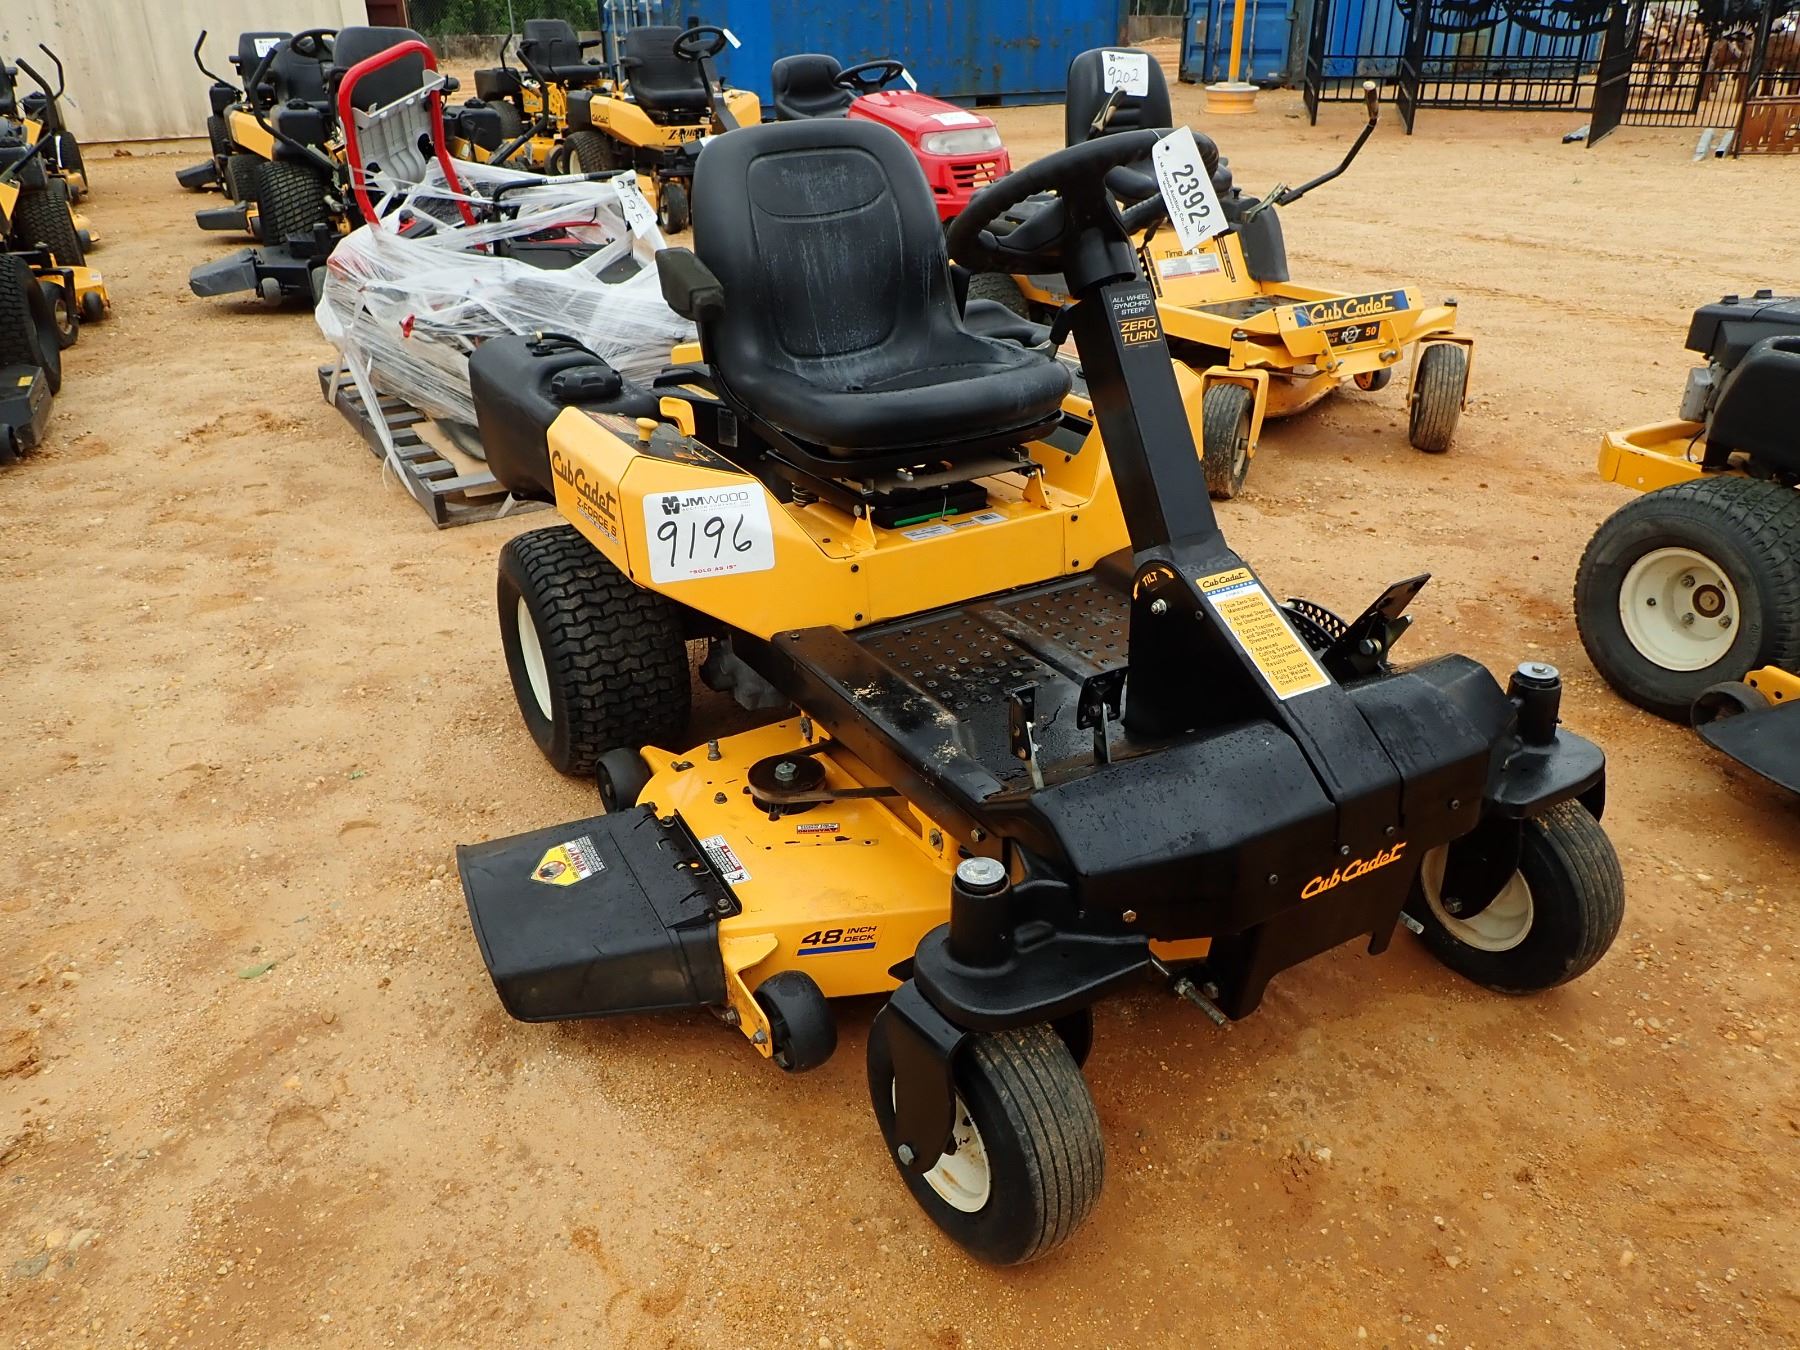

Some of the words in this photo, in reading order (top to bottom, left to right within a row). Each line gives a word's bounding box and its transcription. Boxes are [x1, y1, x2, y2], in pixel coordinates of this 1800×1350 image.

[1108, 67, 1139, 84] 9202
[1163, 171, 1172, 189] Wood
[1170, 189, 1182, 213] Auction
[1171, 163, 1210, 225] 2392
[1164, 248, 1183, 259] Time
[1113, 299, 1151, 310] SYNCHRO
[1126, 293, 1150, 302] WHEEL
[1310, 302, 1342, 321] Cub
[1343, 294, 1393, 317] Cadet
[1120, 318, 1156, 333] ZERO
[1365, 326, 1377, 337] 50
[1121, 329, 1158, 343] TURN
[551, 449, 574, 487] Cub
[574, 468, 617, 522] Cadet
[657, 513, 753, 568] 9196
[1142, 571, 1158, 587] TILT
[1202, 579, 1219, 589] Cub
[1219, 572, 1247, 584] Cadet
[567, 846, 587, 873] DANGER
[1300, 867, 1341, 900] Cub
[1341, 841, 1408, 882] Cadet
[801, 928, 844, 946] 48
[847, 925, 878, 935] INCH
[843, 933, 876, 943] DECK
